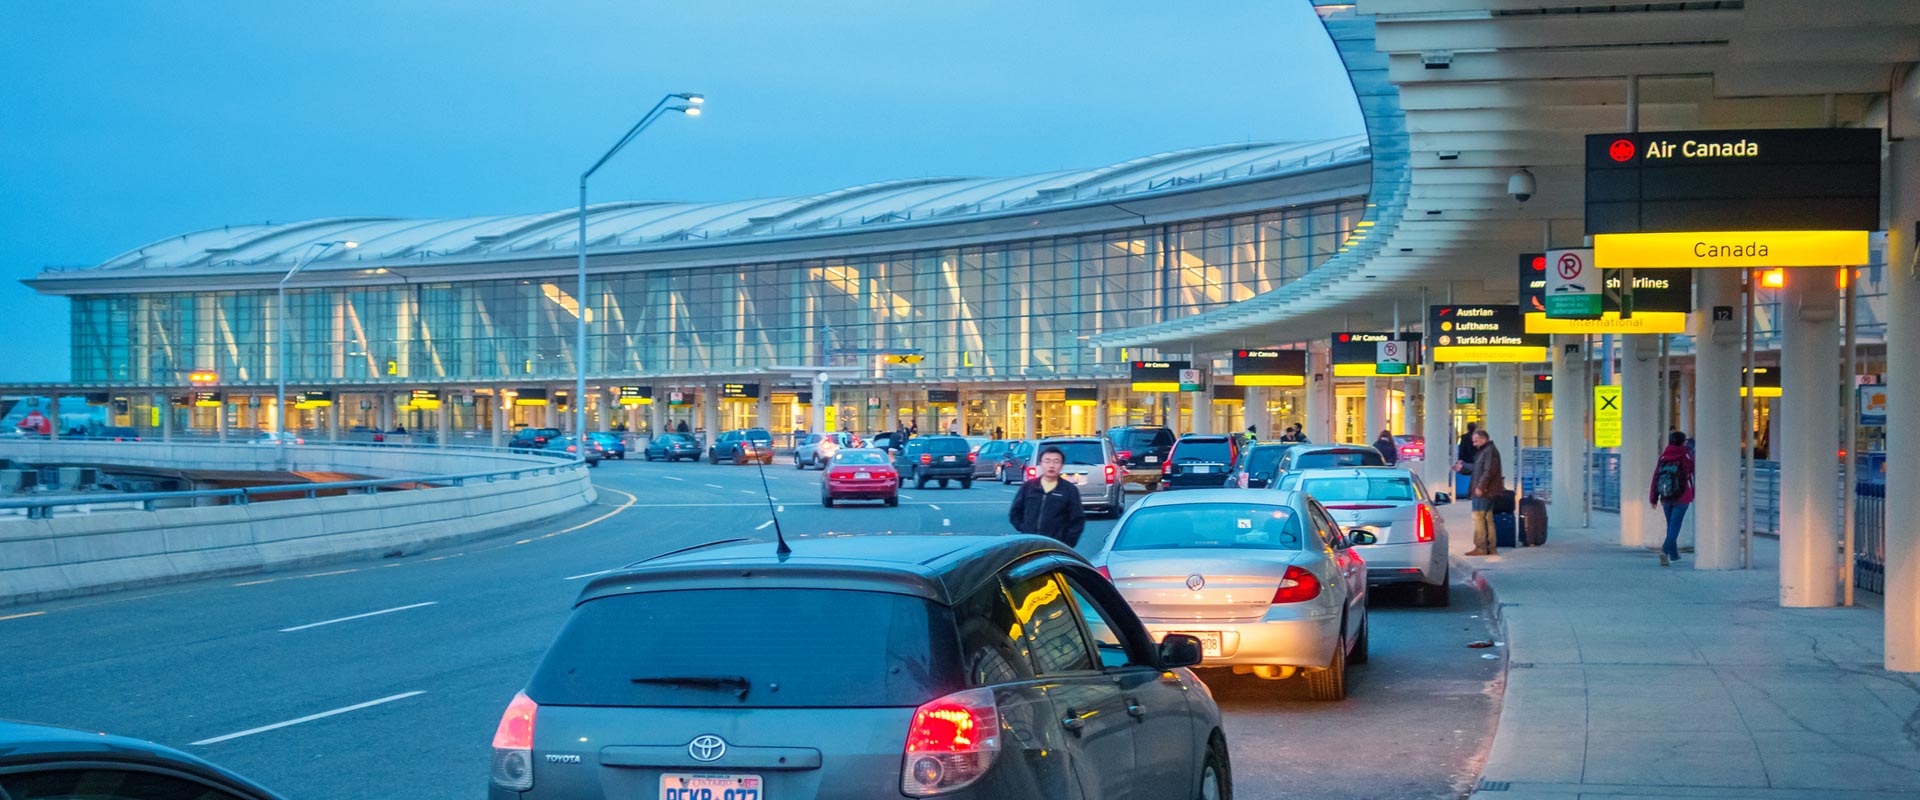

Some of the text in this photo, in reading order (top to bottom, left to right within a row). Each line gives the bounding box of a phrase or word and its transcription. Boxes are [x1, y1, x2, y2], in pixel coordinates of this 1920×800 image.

[1646, 139, 1759, 159] Air Canada
[1694, 241, 1769, 258] Canada
[1529, 280, 1546, 288] LOT
[1632, 277, 1669, 288] irlines
[1456, 308, 1494, 316] Austrian
[1455, 322, 1499, 331] Lufthansa
[1456, 336, 1522, 344] Turkish Airlines
[545, 754, 581, 764] TOYOTA
